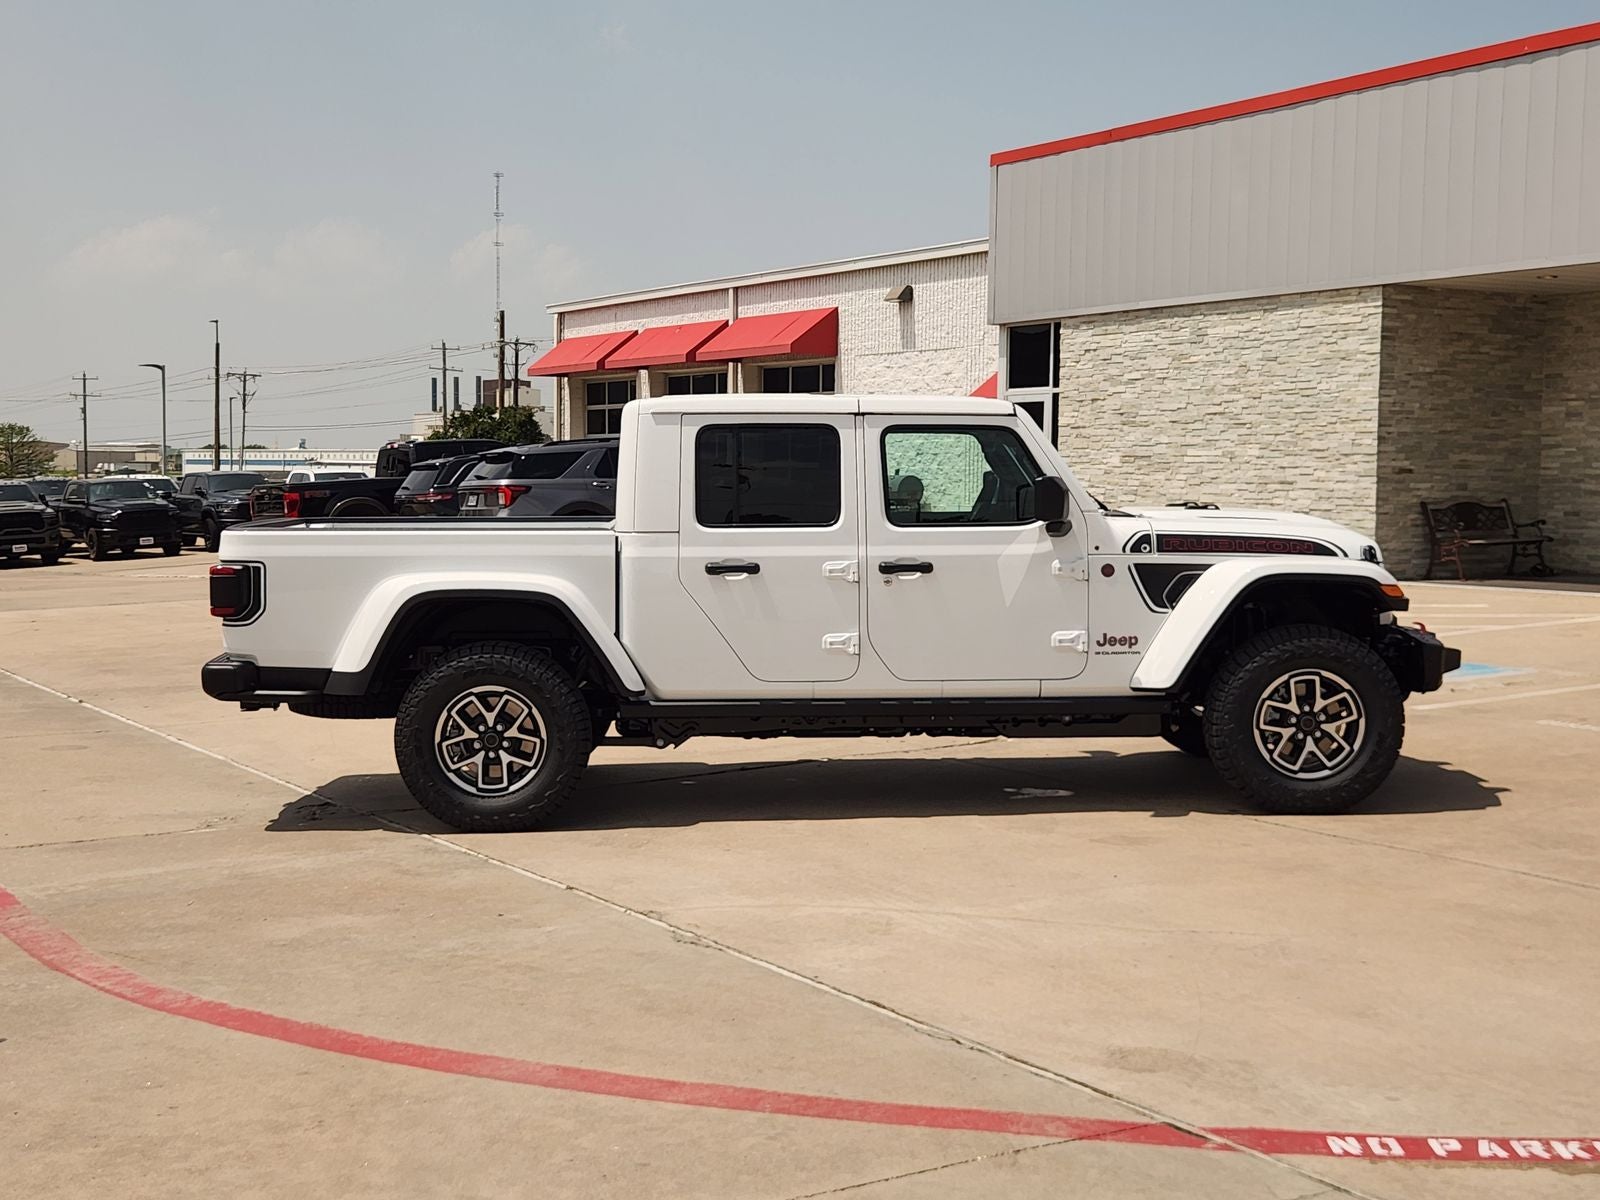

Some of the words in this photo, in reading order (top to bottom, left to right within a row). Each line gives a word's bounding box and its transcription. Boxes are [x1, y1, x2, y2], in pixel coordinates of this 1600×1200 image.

[1162, 537, 1316, 554] RUBICON
[1095, 632, 1139, 649] Jeep
[1325, 1135, 1405, 1157] NO
[1426, 1137, 1600, 1161] PARK
